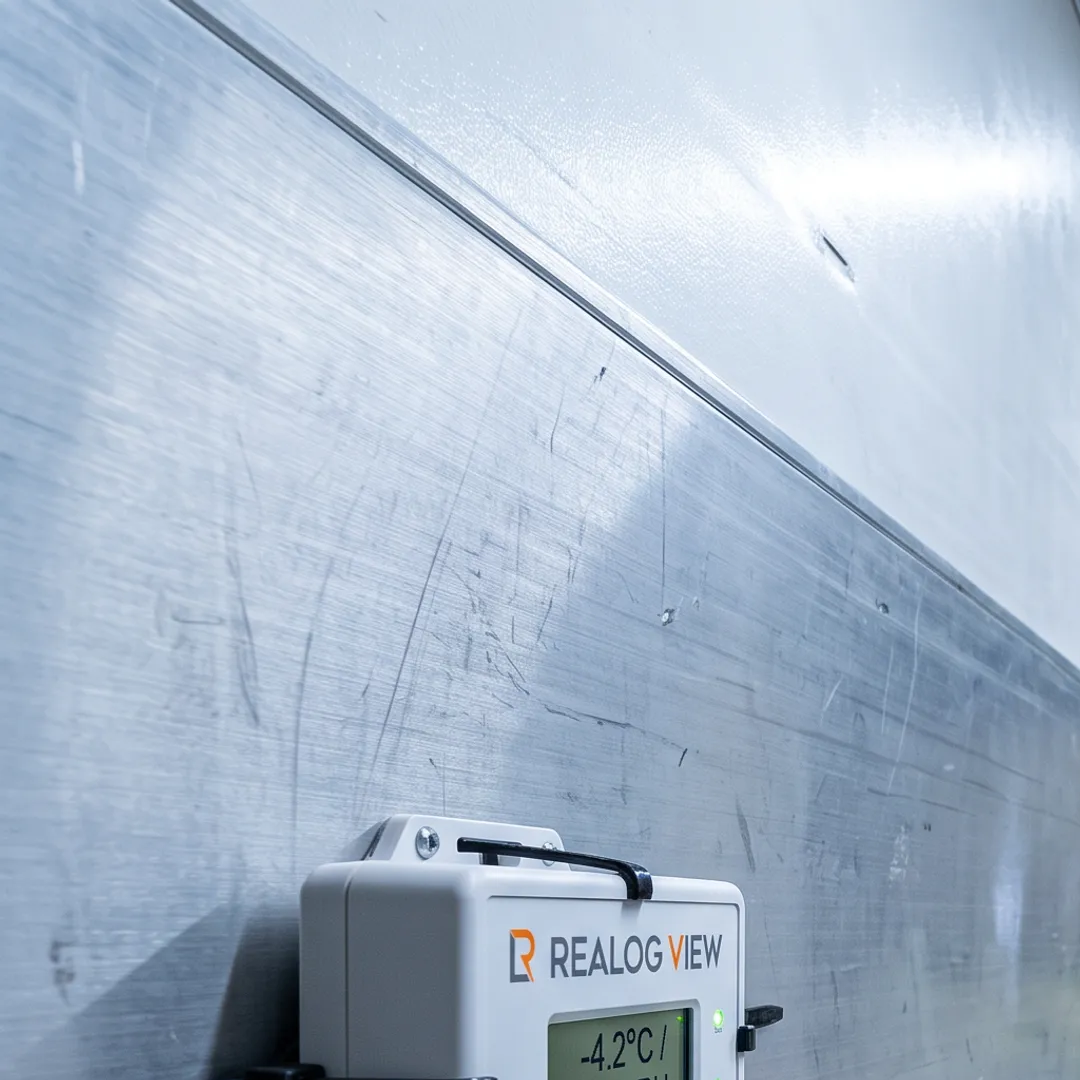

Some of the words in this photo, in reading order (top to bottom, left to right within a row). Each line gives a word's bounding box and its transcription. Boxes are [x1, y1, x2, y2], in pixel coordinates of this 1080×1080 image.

[550, 935, 663, 978] REALOG
[668, 934, 723, 970] VIEW
[581, 1026, 654, 1071] -4.2°C
